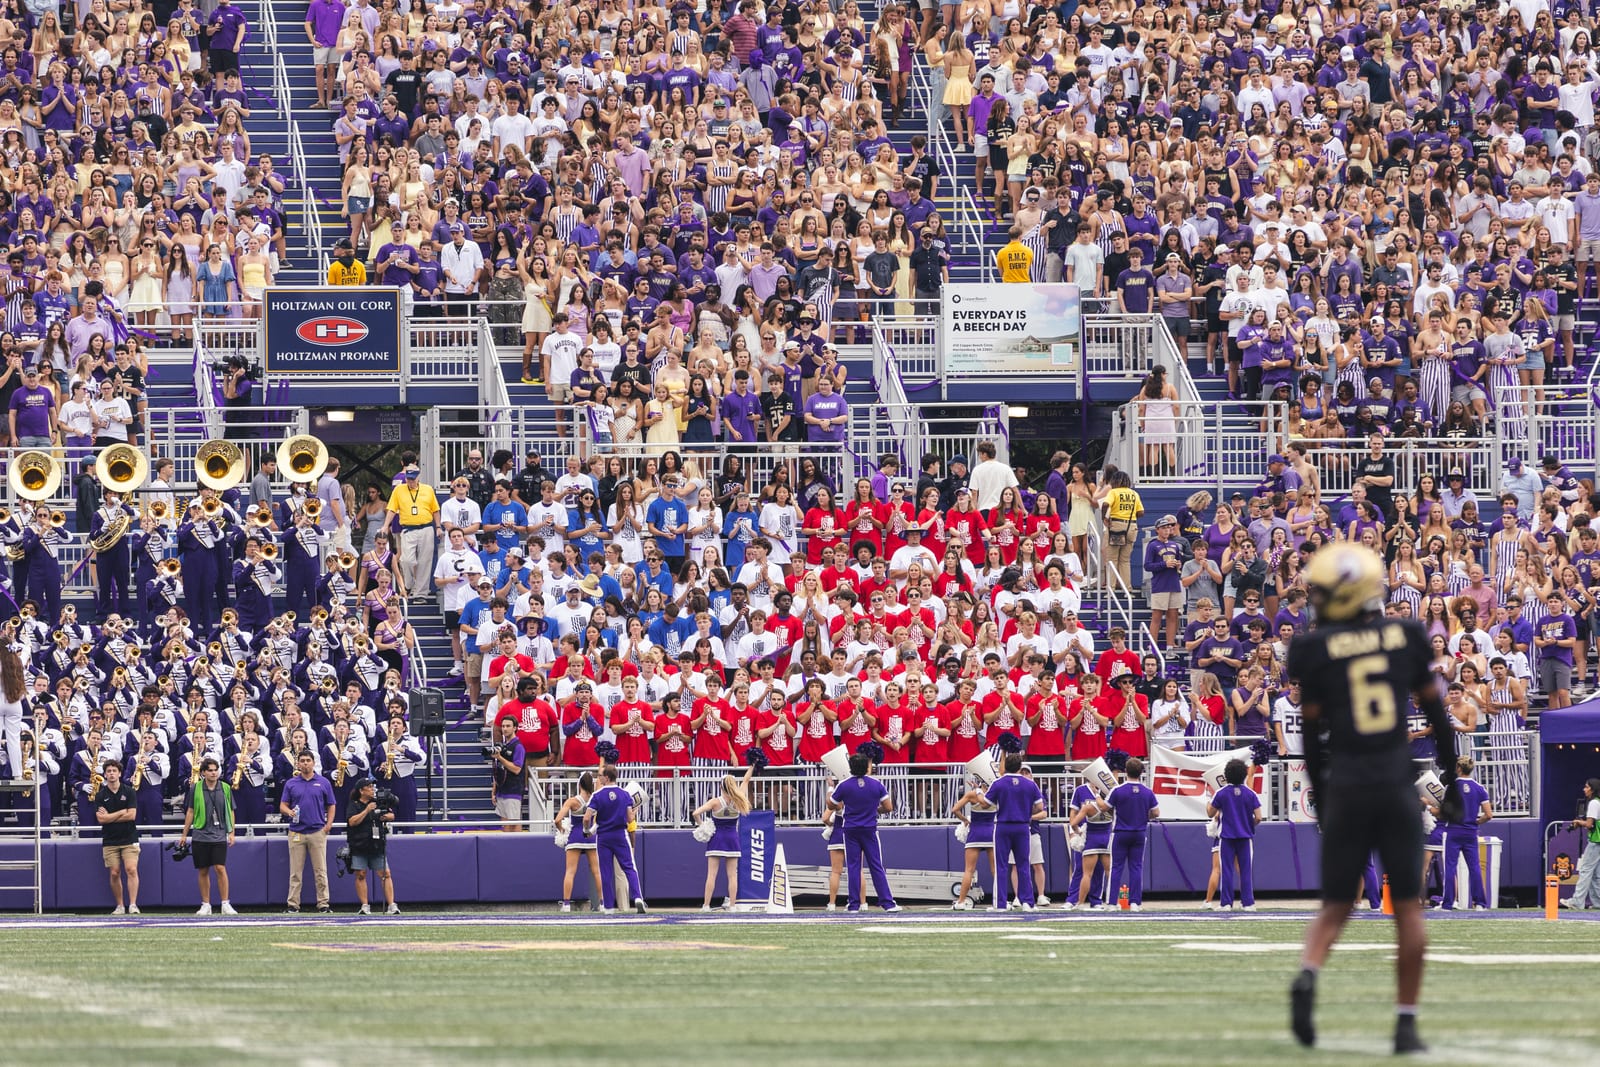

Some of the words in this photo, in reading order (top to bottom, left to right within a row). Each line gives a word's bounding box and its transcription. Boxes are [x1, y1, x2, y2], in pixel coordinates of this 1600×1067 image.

[669, 76, 689, 84] JMU
[1070, 163, 1085, 172] MU
[1009, 262, 1027, 270] EVENTS
[652, 277, 671, 285] JMU
[1126, 277, 1147, 285] JMU
[271, 301, 334, 311] HOLTZMAN
[337, 301, 357, 311] OIL
[360, 301, 393, 311] CORP.
[952, 310, 1014, 320] EVERYDAY
[1016, 310, 1027, 320] IS
[952, 322, 961, 332] A
[964, 322, 1000, 332] BEECH
[1003, 322, 1027, 332] DAY
[554, 339, 577, 350] MADISON
[276, 351, 337, 361] HOLTZMAN
[340, 351, 389, 361] PROPANE
[624, 370, 640, 379] JMU
[814, 401, 838, 409] JMU
[770, 409, 785, 428] 26
[1364, 463, 1384, 472] JMU
[1119, 503, 1135, 511] EVENT
[1347, 654, 1397, 735] 6
[1286, 715, 1304, 734] 25
[1152, 765, 1264, 797] ESN
[750, 828, 765, 883] DUKES
[772, 864, 787, 907] JMU
